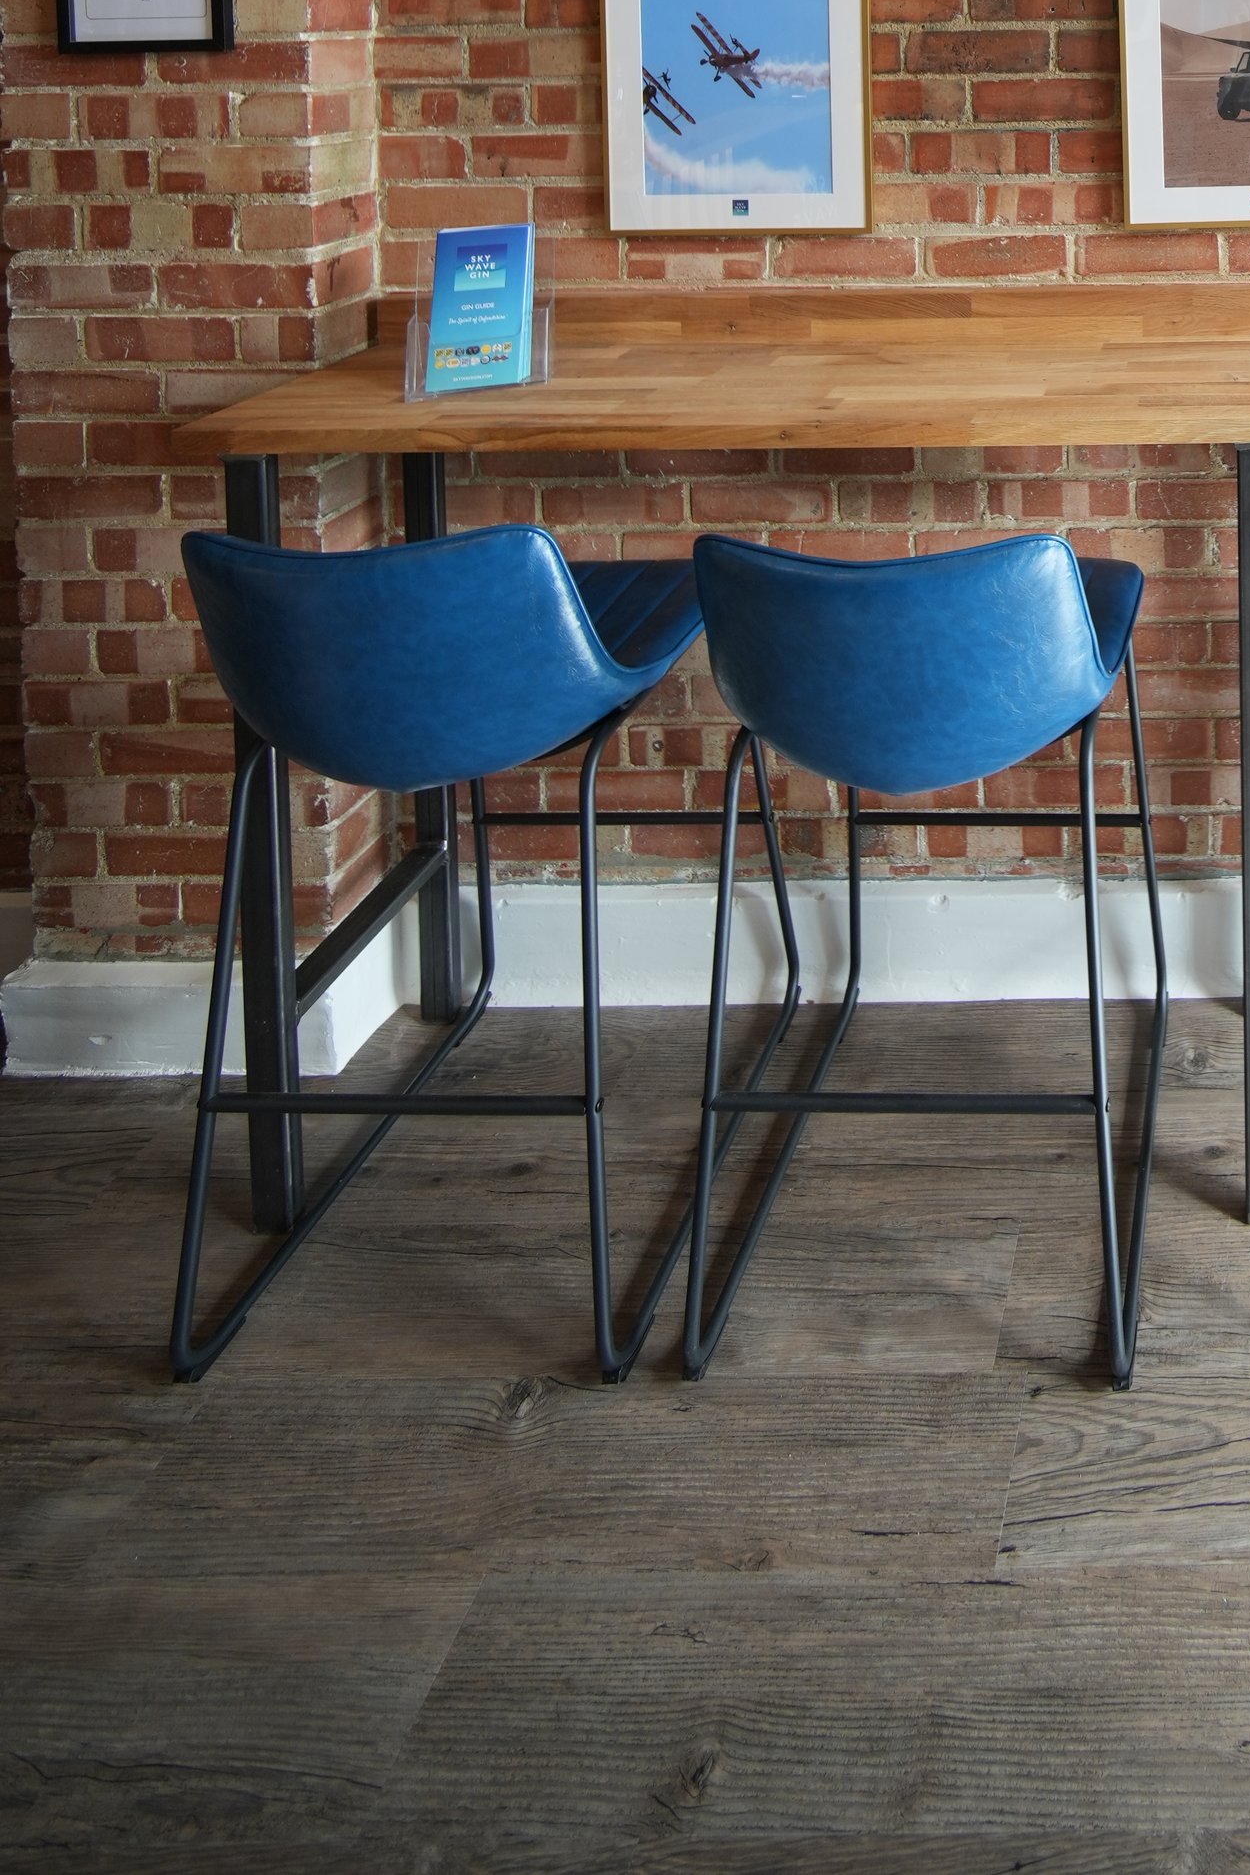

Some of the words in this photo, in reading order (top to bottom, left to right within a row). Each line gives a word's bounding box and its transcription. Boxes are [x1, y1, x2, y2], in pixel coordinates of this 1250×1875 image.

[470, 255, 491, 263] SKY
[465, 262, 495, 271] WAVE
[470, 271, 489, 279] GIN
